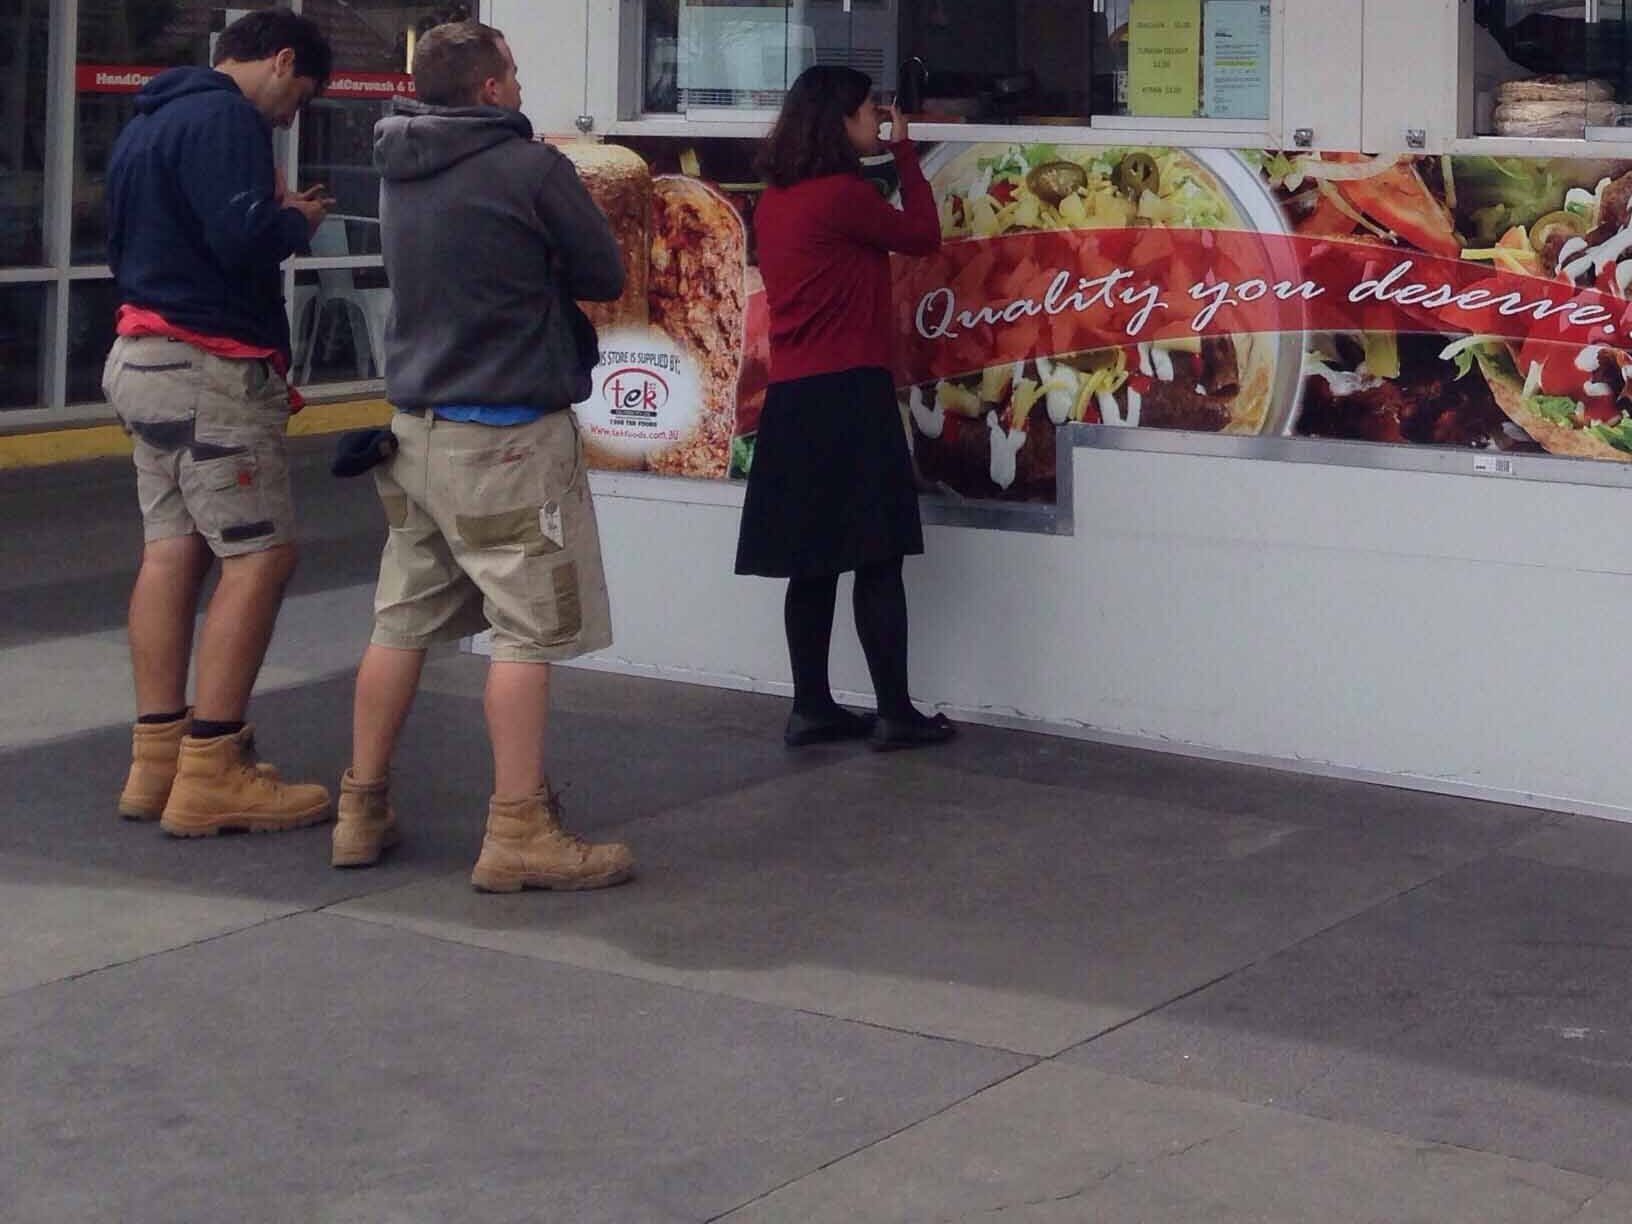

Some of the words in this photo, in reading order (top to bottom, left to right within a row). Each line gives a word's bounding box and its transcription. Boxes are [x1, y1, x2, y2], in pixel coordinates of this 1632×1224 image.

[96, 72, 153, 86] HandCa
[914, 267, 1169, 337] Quality
[1187, 278, 1325, 332] you
[607, 351, 629, 365] STORE
[630, 351, 637, 364] IS
[637, 352, 669, 369] SUPPLIED
[610, 378, 657, 410] tek
